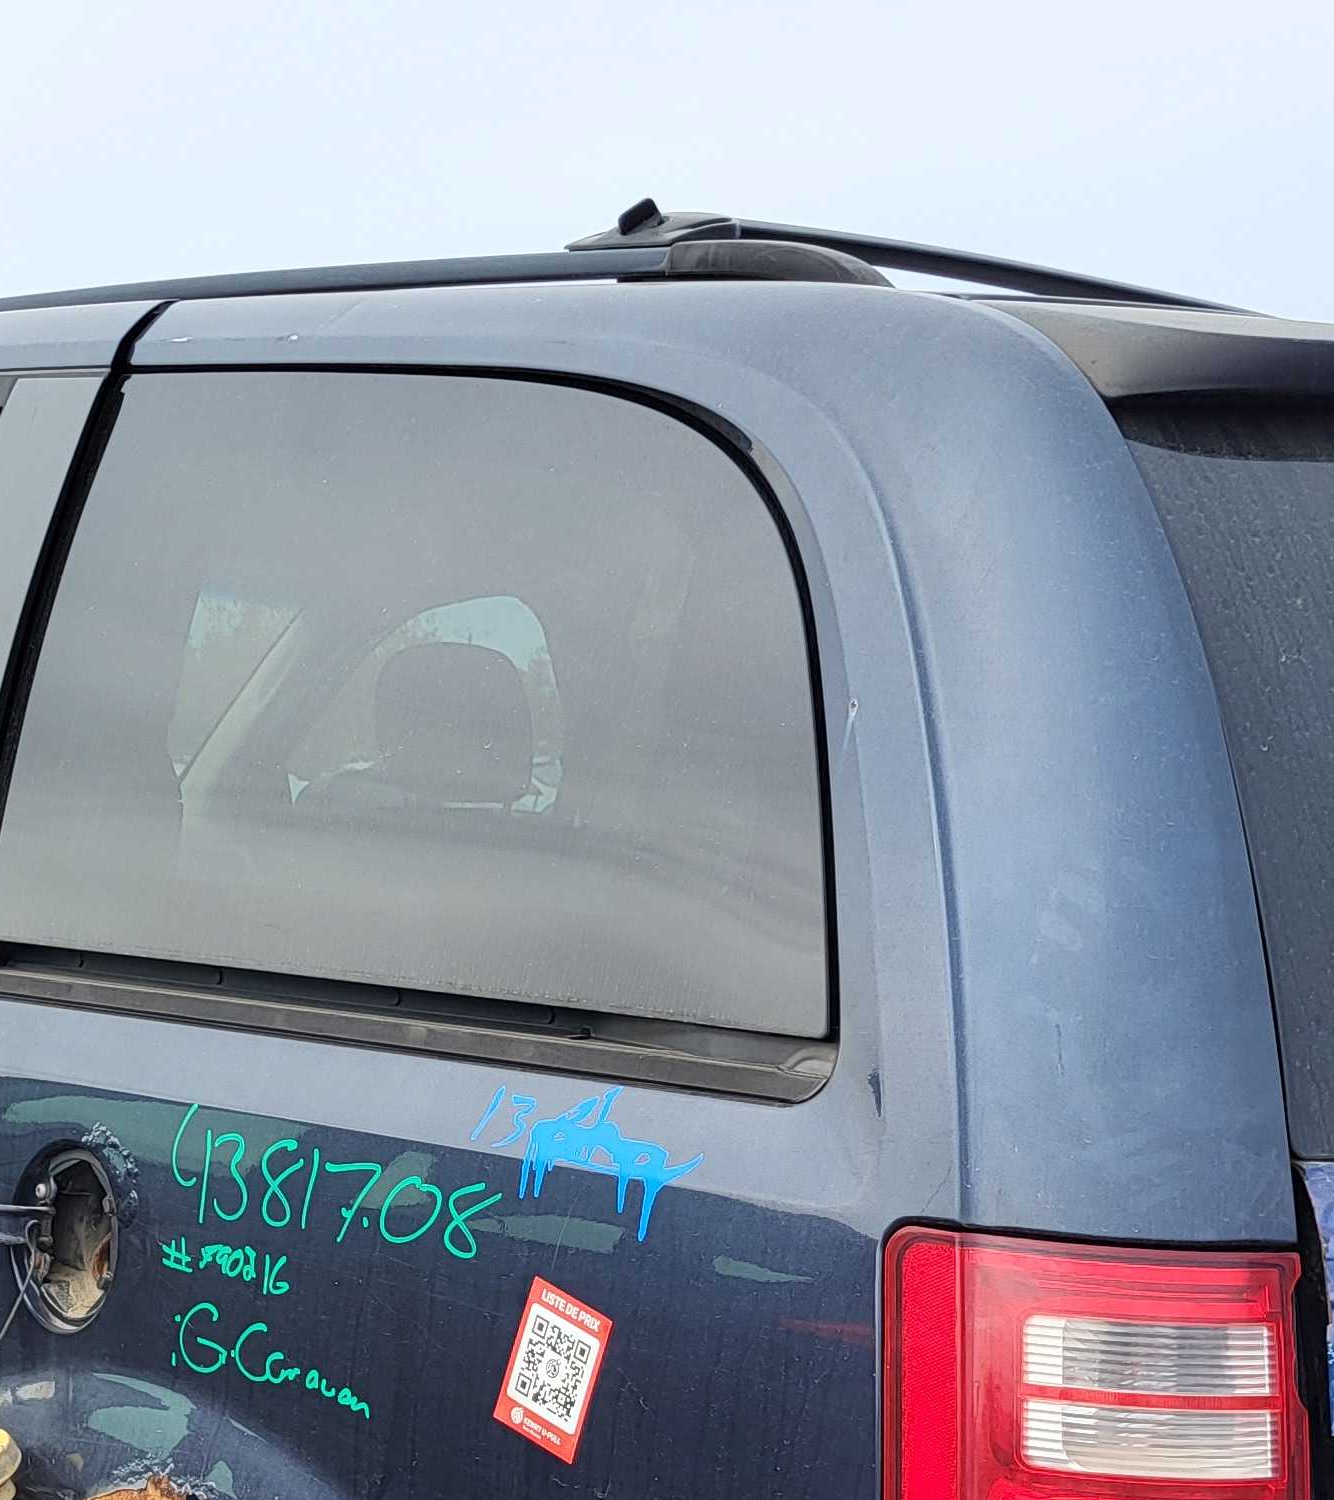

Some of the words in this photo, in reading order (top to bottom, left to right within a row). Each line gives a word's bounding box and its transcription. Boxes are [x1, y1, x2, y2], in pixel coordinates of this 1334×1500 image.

[541, 1288, 566, 1312] LISTE
[565, 1303, 580, 1320] DE
[578, 1310, 601, 1333] PRIX
